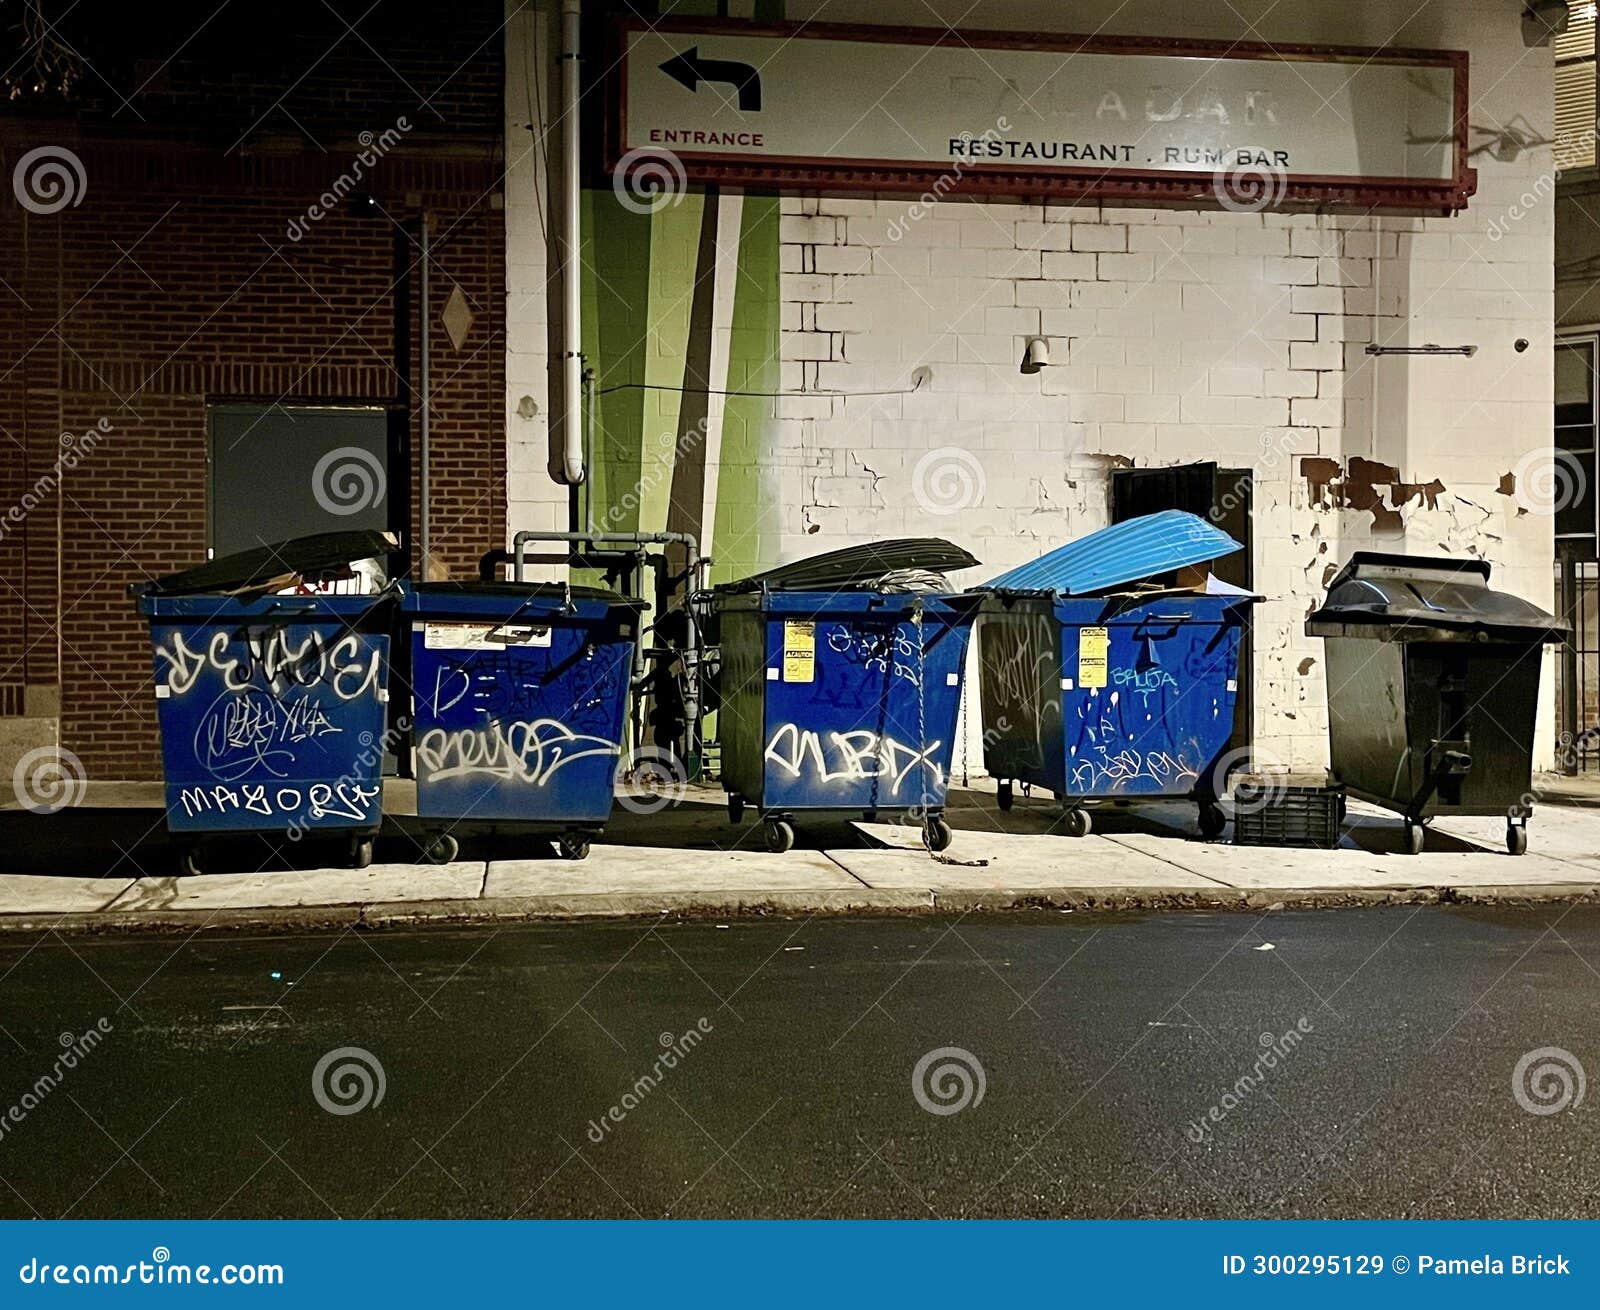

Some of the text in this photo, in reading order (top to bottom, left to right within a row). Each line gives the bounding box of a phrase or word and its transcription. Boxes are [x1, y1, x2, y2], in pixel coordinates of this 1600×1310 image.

[649, 128, 764, 147] ENTRANCE
[949, 138, 1136, 162] RESTAURANT
[1164, 146, 1223, 165] RUM
[1236, 149, 1290, 168] BAR
